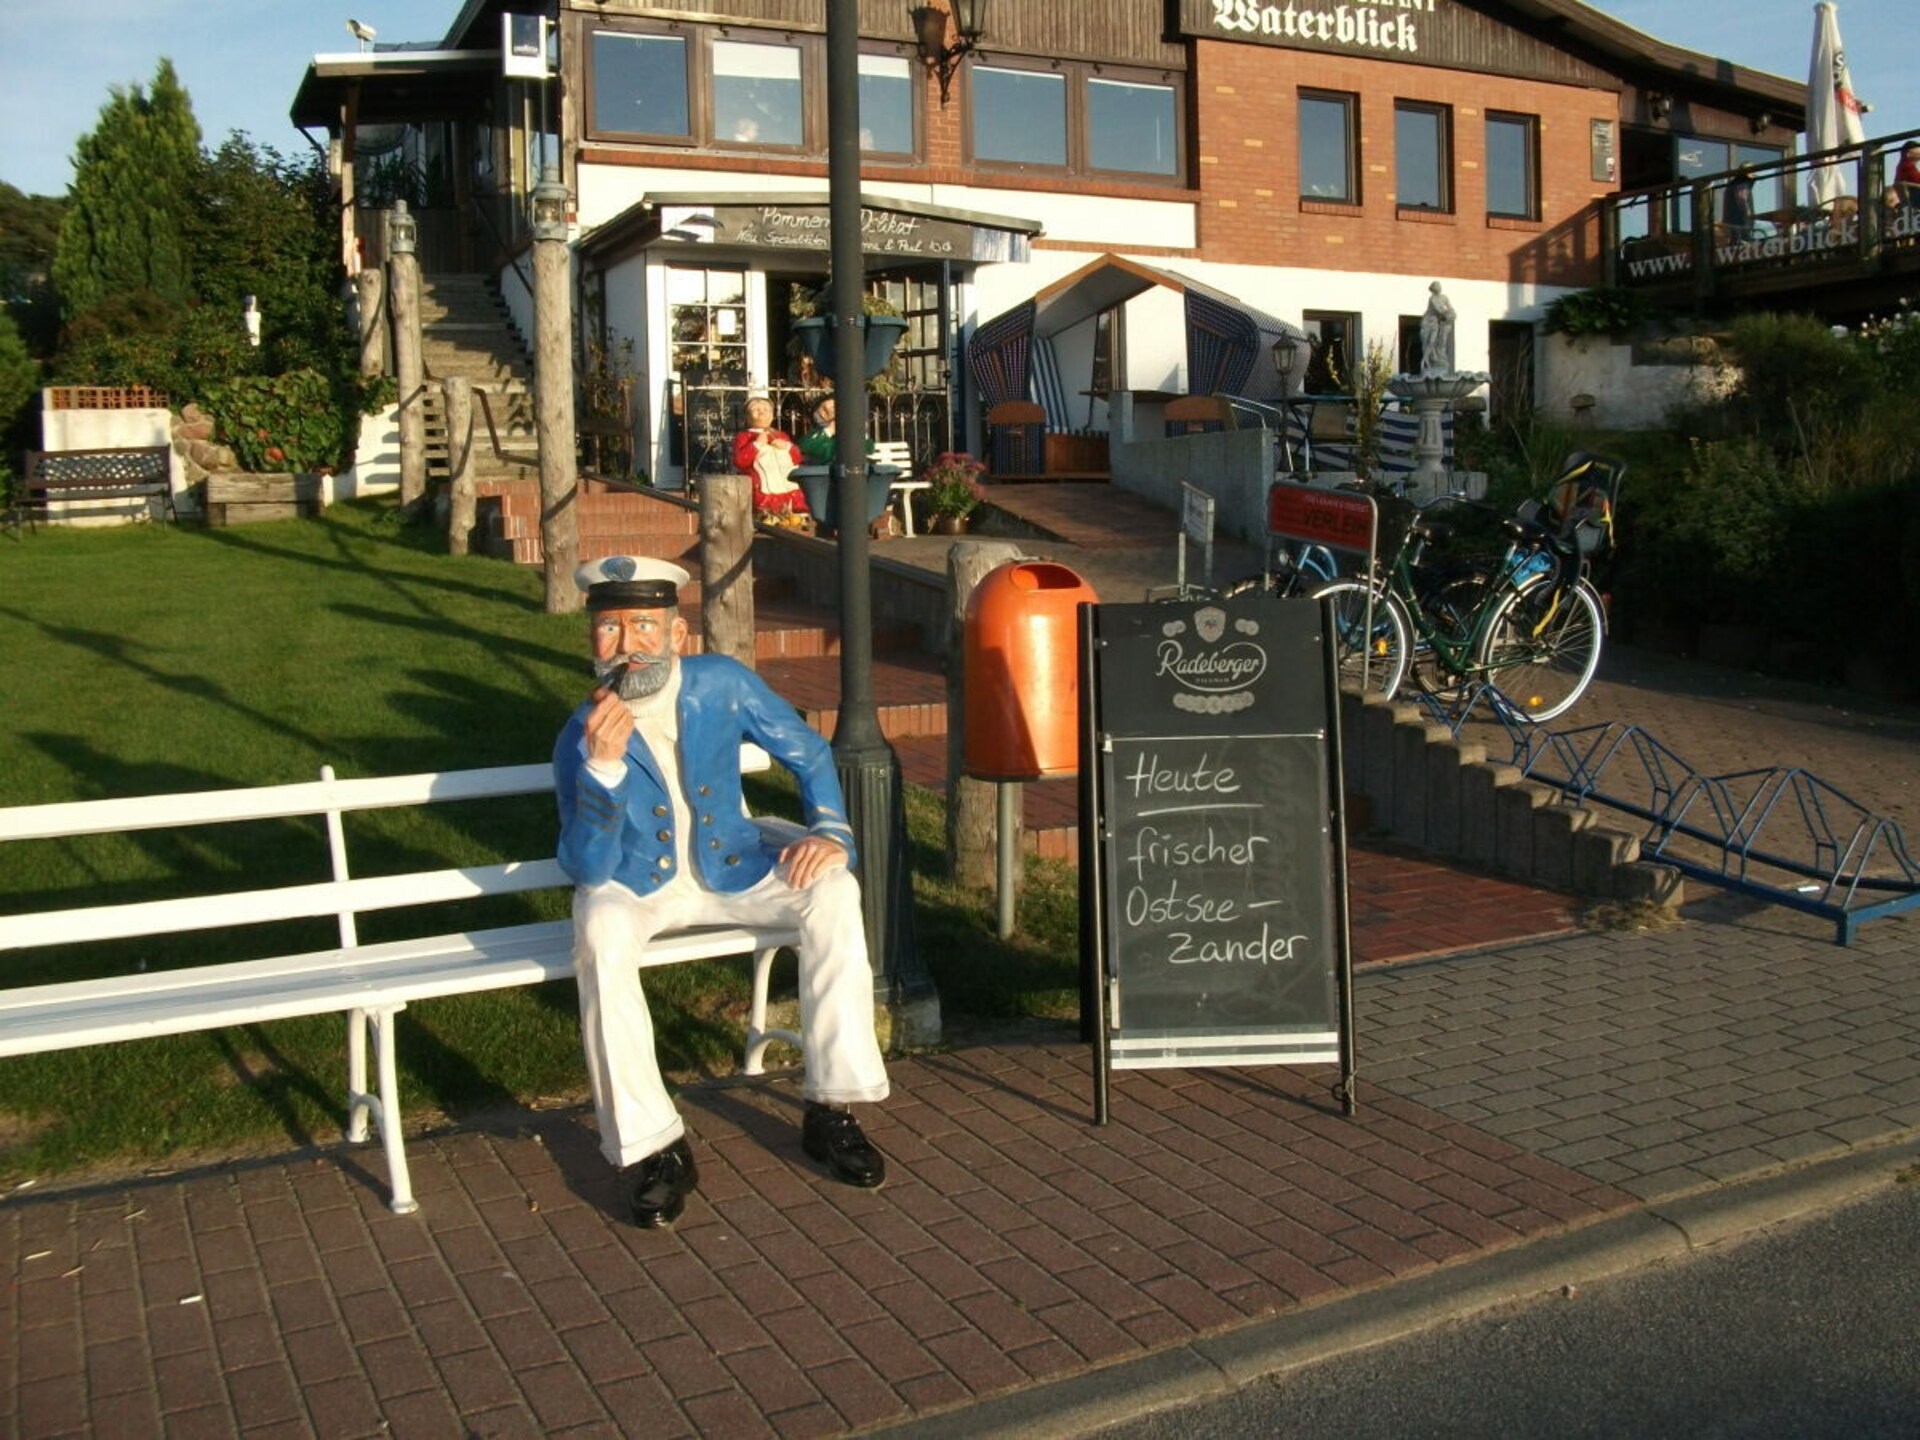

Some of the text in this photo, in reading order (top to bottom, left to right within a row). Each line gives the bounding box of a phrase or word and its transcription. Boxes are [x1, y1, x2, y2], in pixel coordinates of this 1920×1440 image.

[1213, 0, 1418, 52] Waterblick
[1156, 639, 1261, 681] Radeberger
[1126, 752, 1241, 798] Heute
[1128, 826, 1269, 882] frischer
[1168, 922, 1308, 965] Zander
